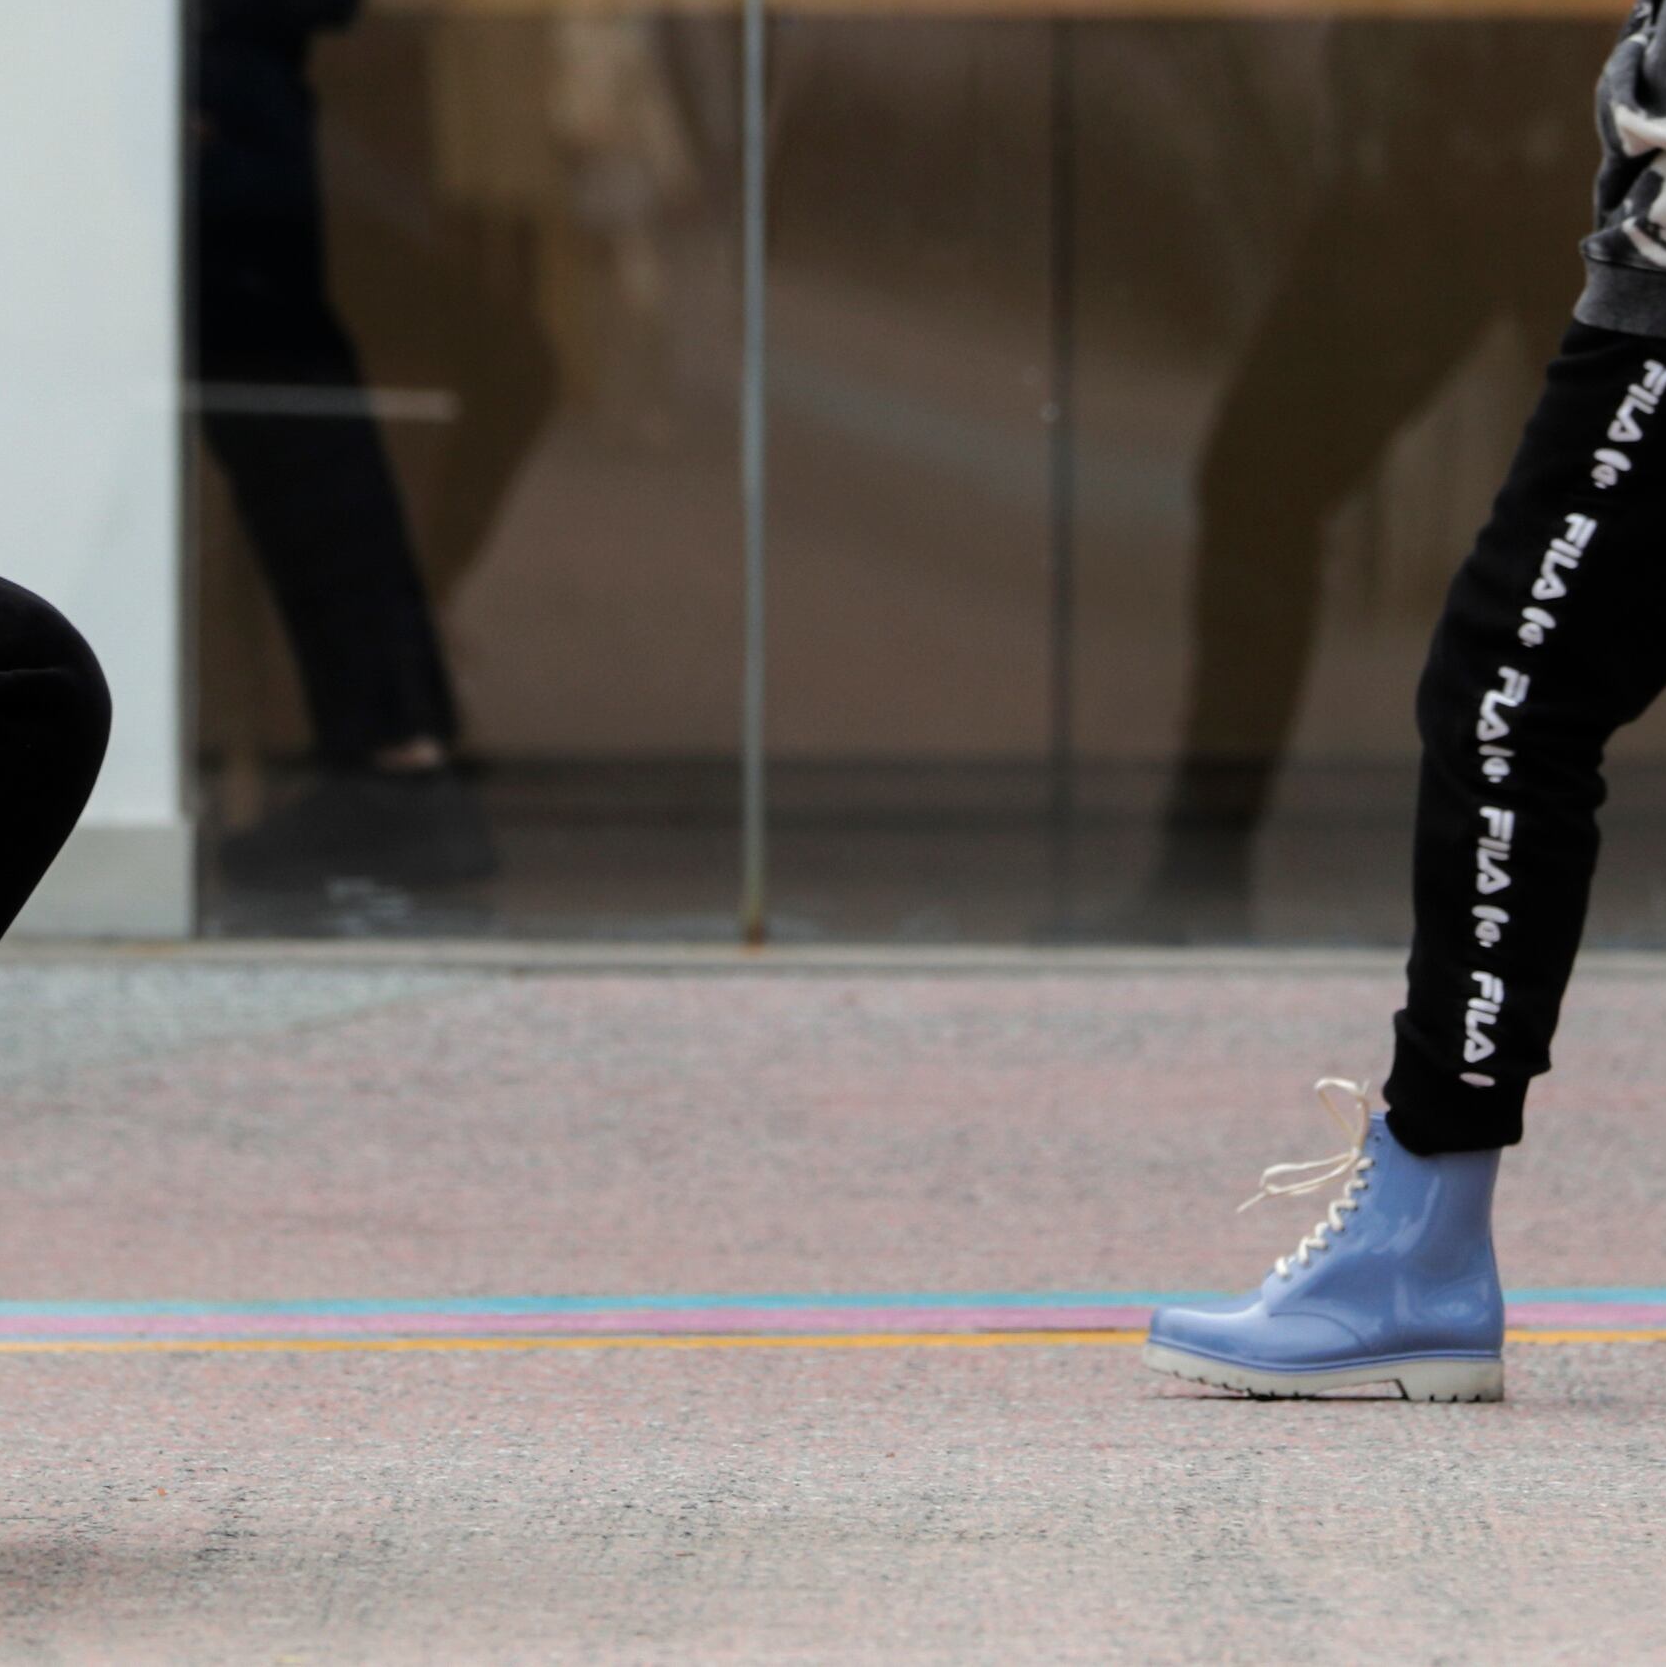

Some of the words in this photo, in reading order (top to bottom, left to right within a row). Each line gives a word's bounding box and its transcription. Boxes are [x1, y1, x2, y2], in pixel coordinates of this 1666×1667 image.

[1531, 512, 1597, 601] FILA
[1476, 806, 1514, 894] FILA
[1463, 970, 1504, 1063] FILA
